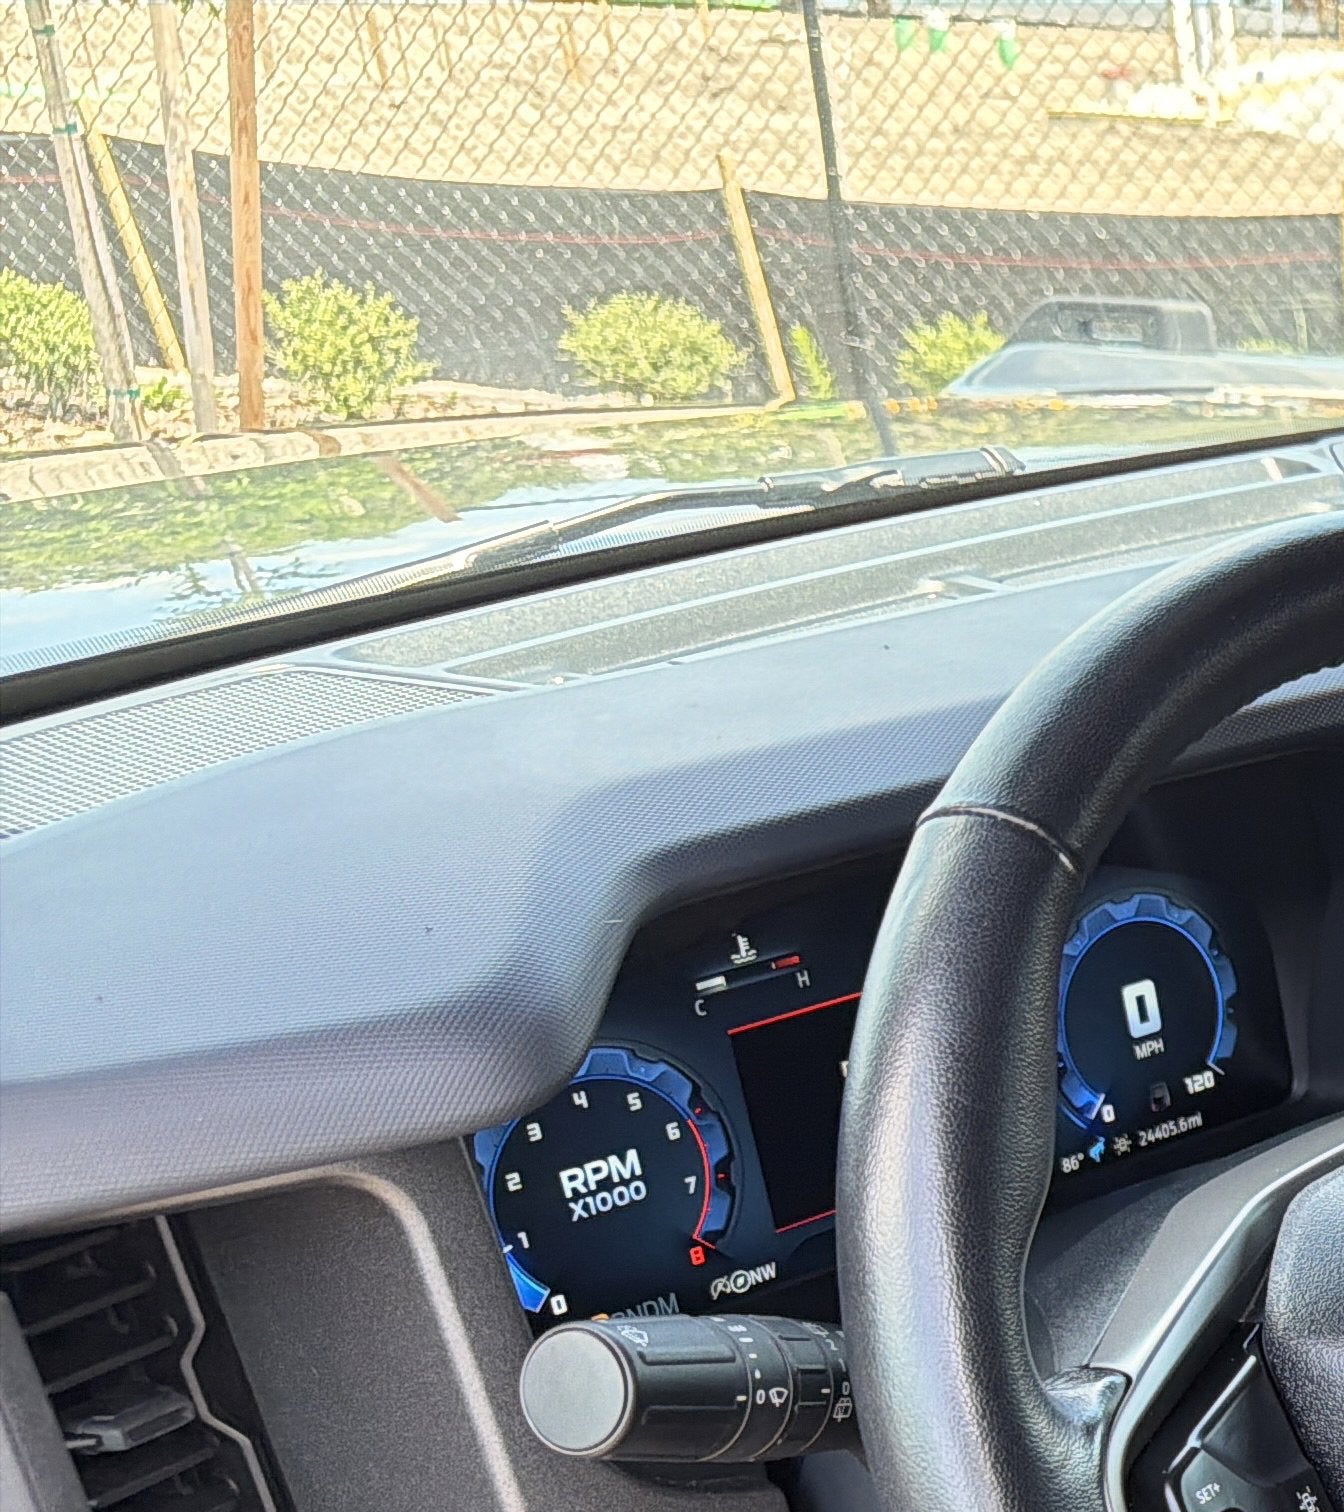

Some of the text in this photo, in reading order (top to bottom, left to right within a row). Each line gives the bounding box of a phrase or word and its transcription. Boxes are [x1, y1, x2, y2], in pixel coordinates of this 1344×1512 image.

[795, 969, 811, 989] H
[694, 999, 707, 1016] C
[1121, 978, 1162, 1039] 0
[1133, 1038, 1165, 1060] MPH
[1182, 1070, 1215, 1095] 120
[571, 1090, 590, 1109] 4
[626, 1092, 643, 1112] 5
[1101, 1104, 1115, 1123] 0
[525, 1122, 544, 1142] 3
[665, 1121, 682, 1141] 6
[505, 1172, 523, 1192] 2
[558, 1148, 643, 1199] RPM
[684, 1175, 697, 1194] 7
[517, 1231, 530, 1249] 1
[689, 1246, 706, 1266] 8
[749, 1261, 777, 1284] NW
[550, 1294, 568, 1316] 0
[1195, 1482, 1221, 1505] SET+
